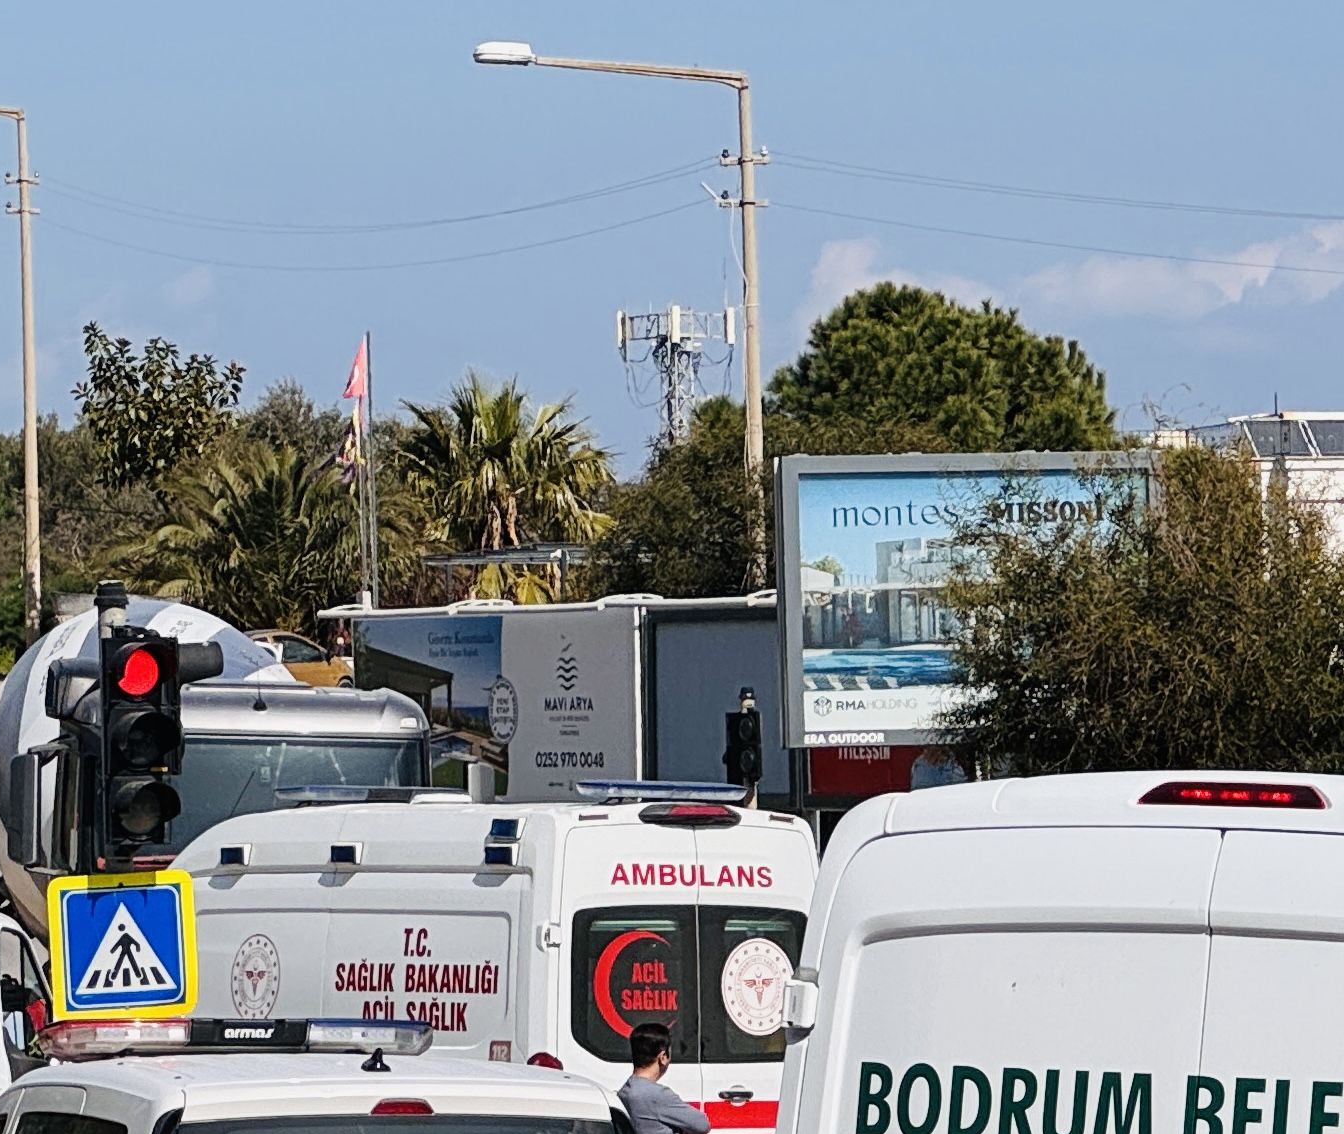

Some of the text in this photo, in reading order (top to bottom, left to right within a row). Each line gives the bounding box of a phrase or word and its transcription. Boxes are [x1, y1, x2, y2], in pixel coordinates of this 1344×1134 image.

[831, 500, 959, 528] montes
[569, 696, 594, 712] ARYA
[828, 732, 885, 744] OUTDOOR
[535, 751, 605, 768] 0252 970 0048
[610, 862, 774, 888] AMBULANS
[403, 927, 432, 958] T.C.
[334, 958, 500, 994] SAĞLIK BAKANLIĞI
[631, 959, 668, 984] ACİL
[621, 986, 678, 1010] SAĞLIK
[406, 996, 468, 1032] SAĞLIK
